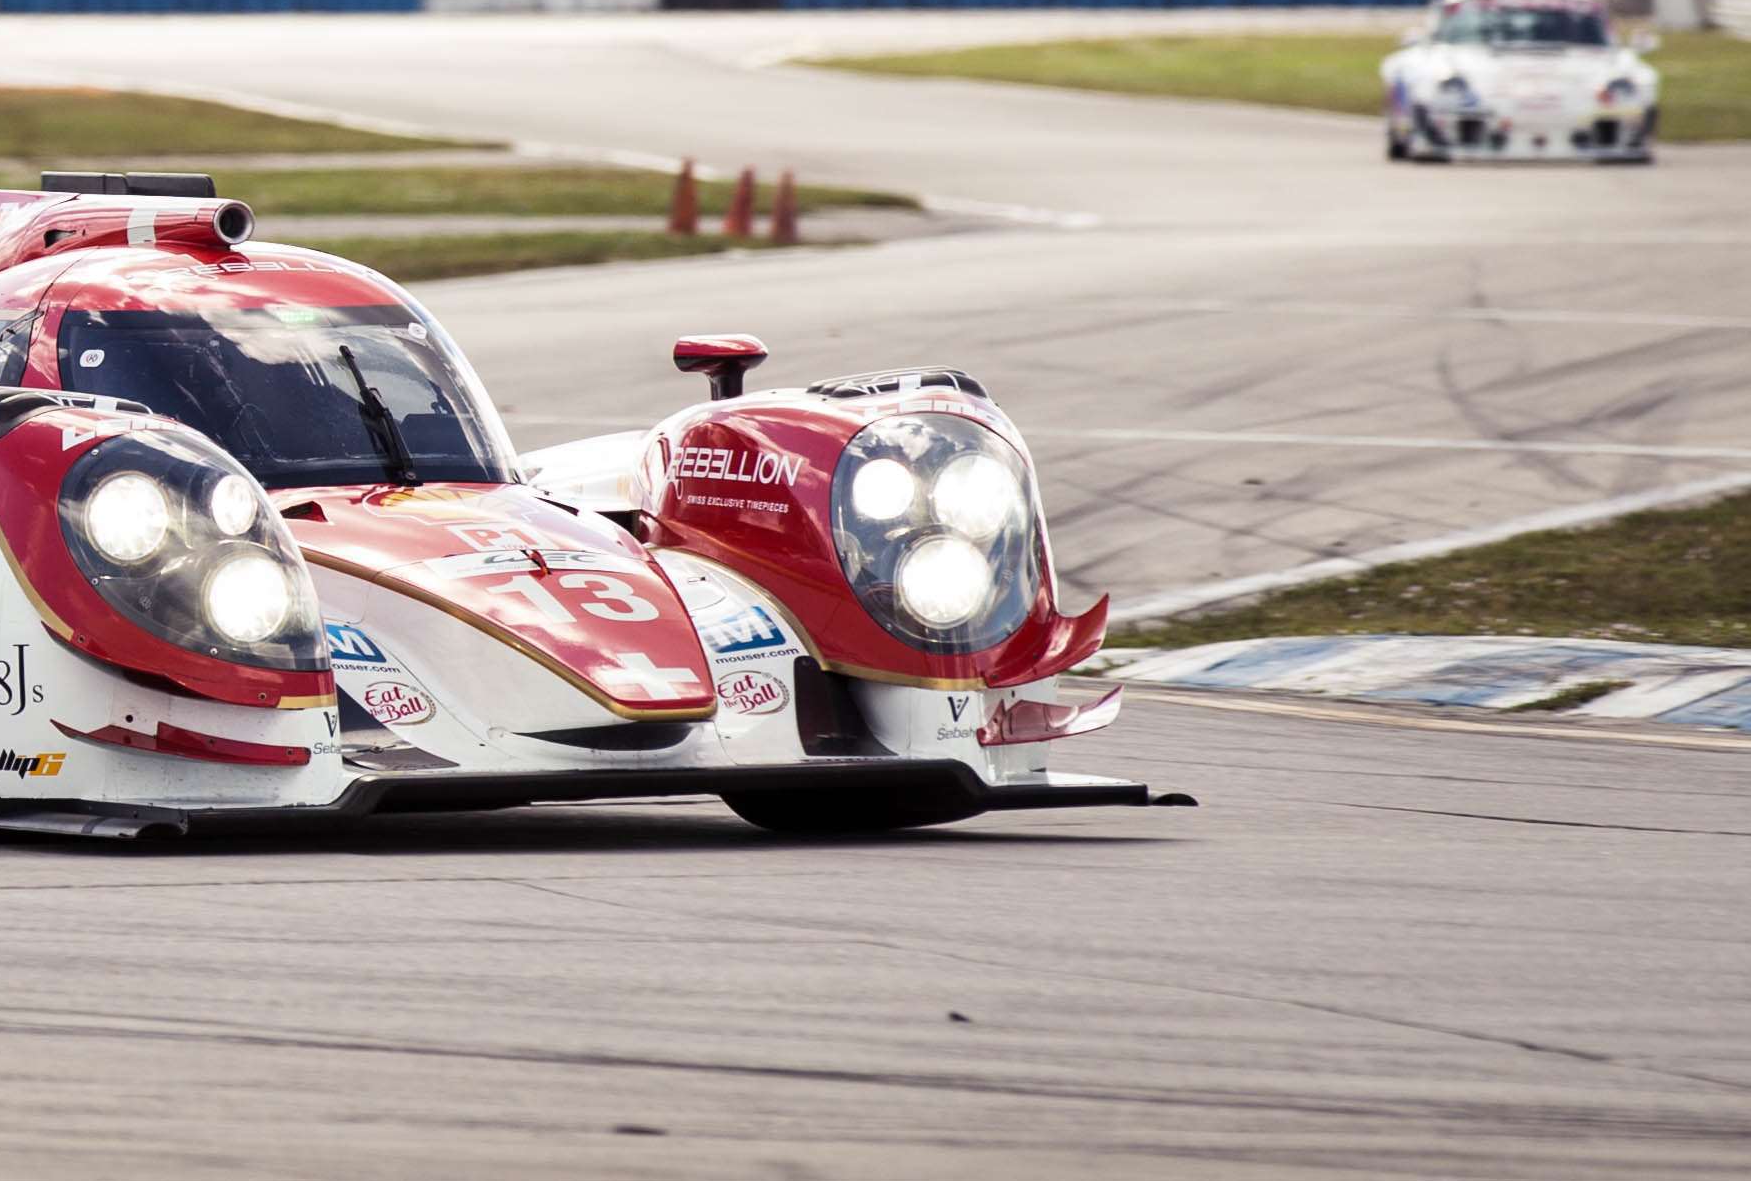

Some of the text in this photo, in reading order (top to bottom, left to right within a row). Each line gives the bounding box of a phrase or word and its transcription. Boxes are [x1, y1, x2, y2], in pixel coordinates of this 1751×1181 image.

[672, 446, 804, 486] REBELLION
[687, 494, 789, 514] SWISS EXCLUSIVE TIMEPIECES
[483, 572, 660, 625] 13
[331, 662, 401, 675] ouser.com
[715, 647, 800, 665] mouser.com
[364, 686, 406, 707] Eat
[717, 674, 758, 699] Eat
[735, 683, 781, 715] Ball
[384, 696, 427, 722] Ball
